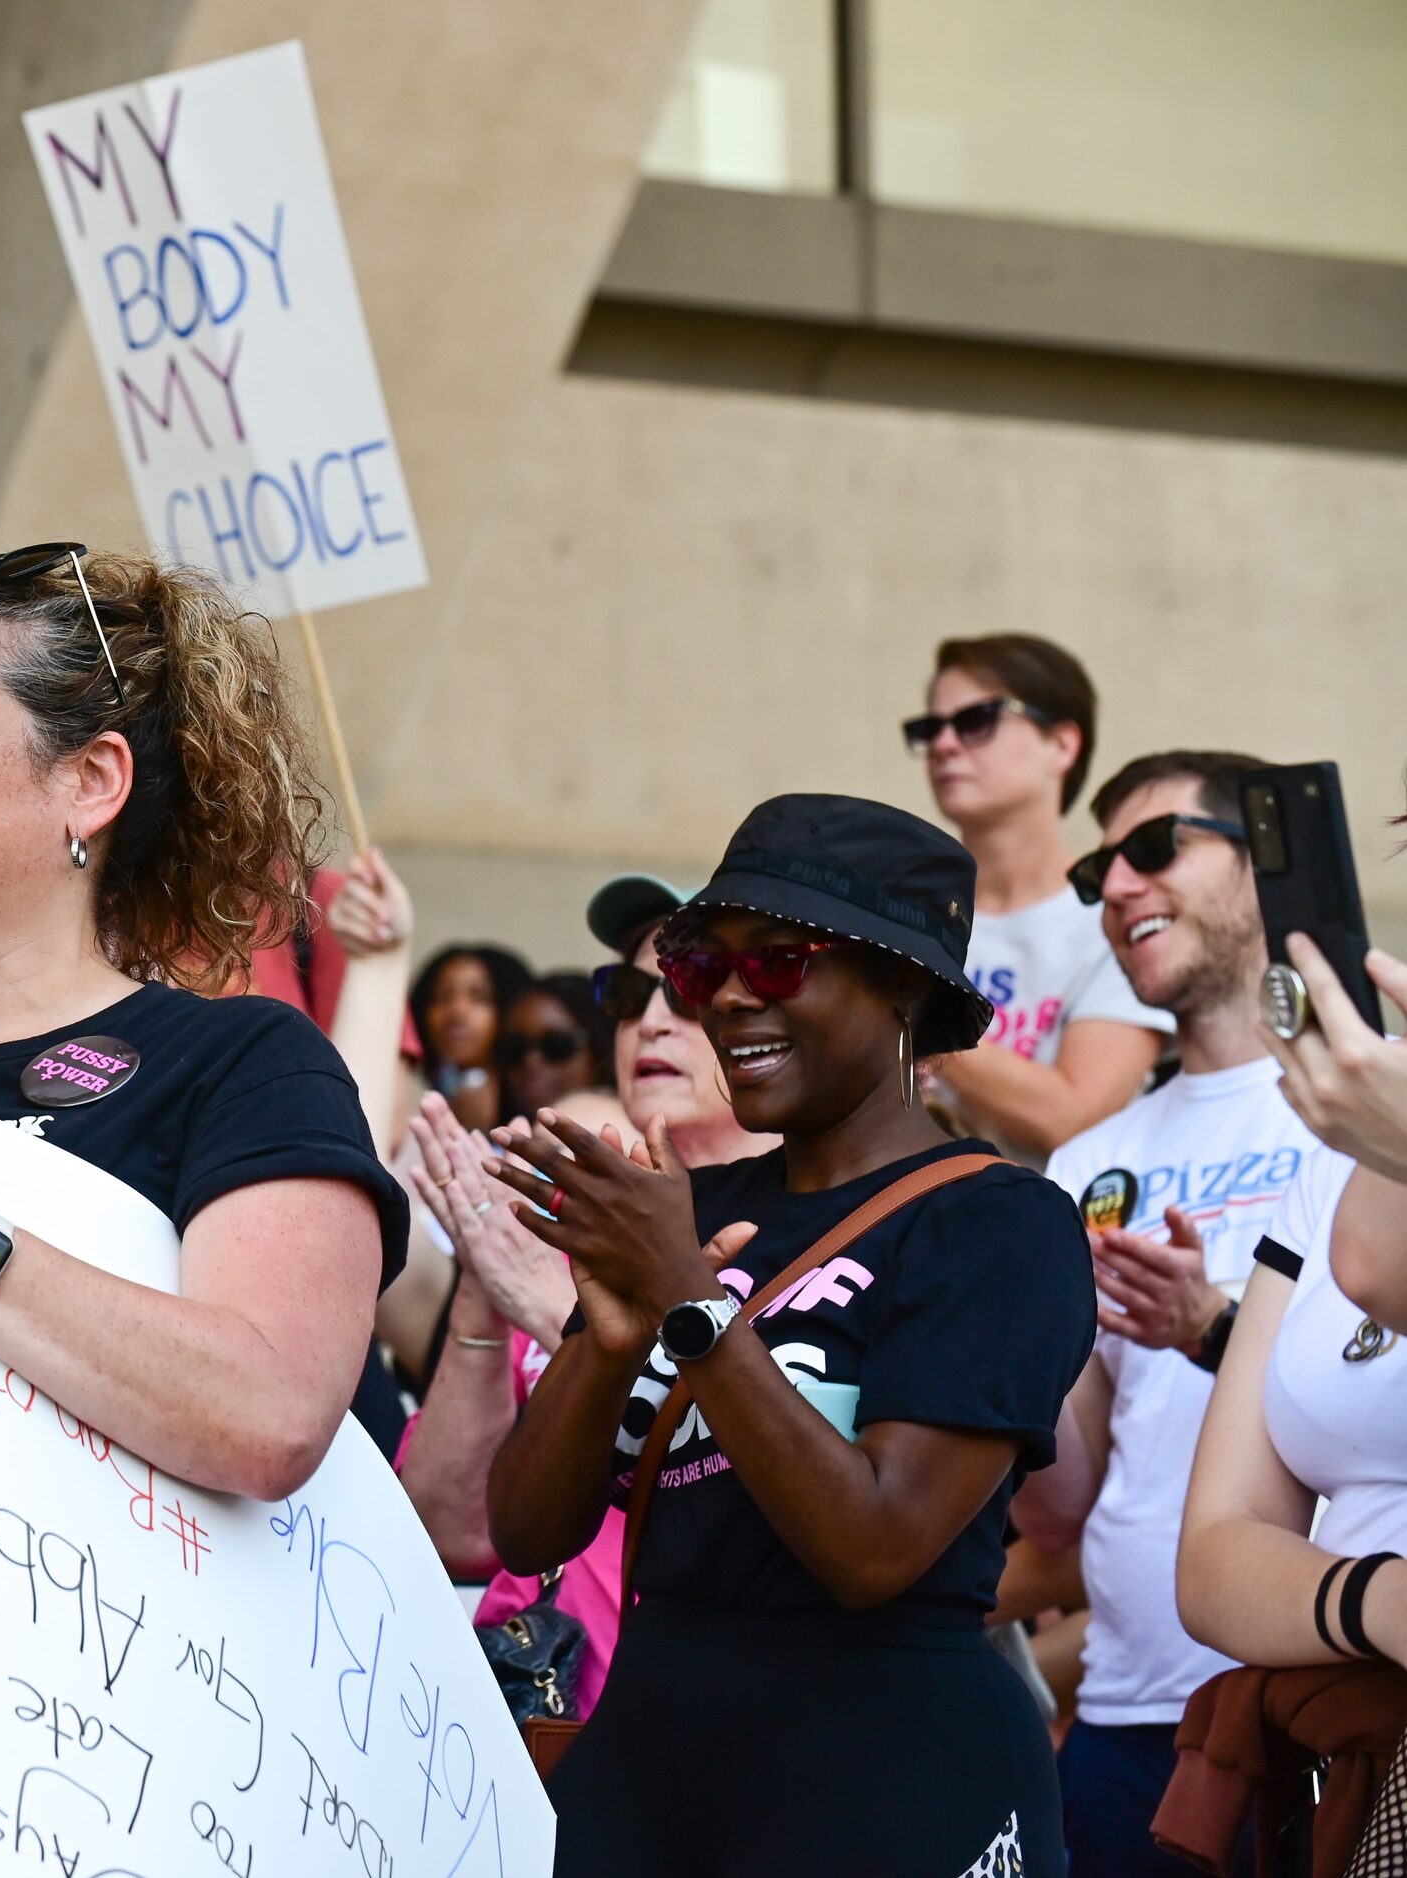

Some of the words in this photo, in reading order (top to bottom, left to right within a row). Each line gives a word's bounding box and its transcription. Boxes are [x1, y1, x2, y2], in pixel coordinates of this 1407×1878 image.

[46, 86, 182, 238] MY
[101, 201, 290, 352] BODY
[117, 326, 246, 464] MY
[165, 439, 407, 583] CHOICE
[32, 1057, 110, 1093] POWER
[56, 1042, 130, 1075] PUSSY
[1138, 1146, 1302, 1218] Pizza
[681, 1460, 703, 1486] ARE
[269, 1498, 396, 1756] Blue
[8, 1675, 154, 1834] Late
[175, 1633, 264, 1792] Gov.
